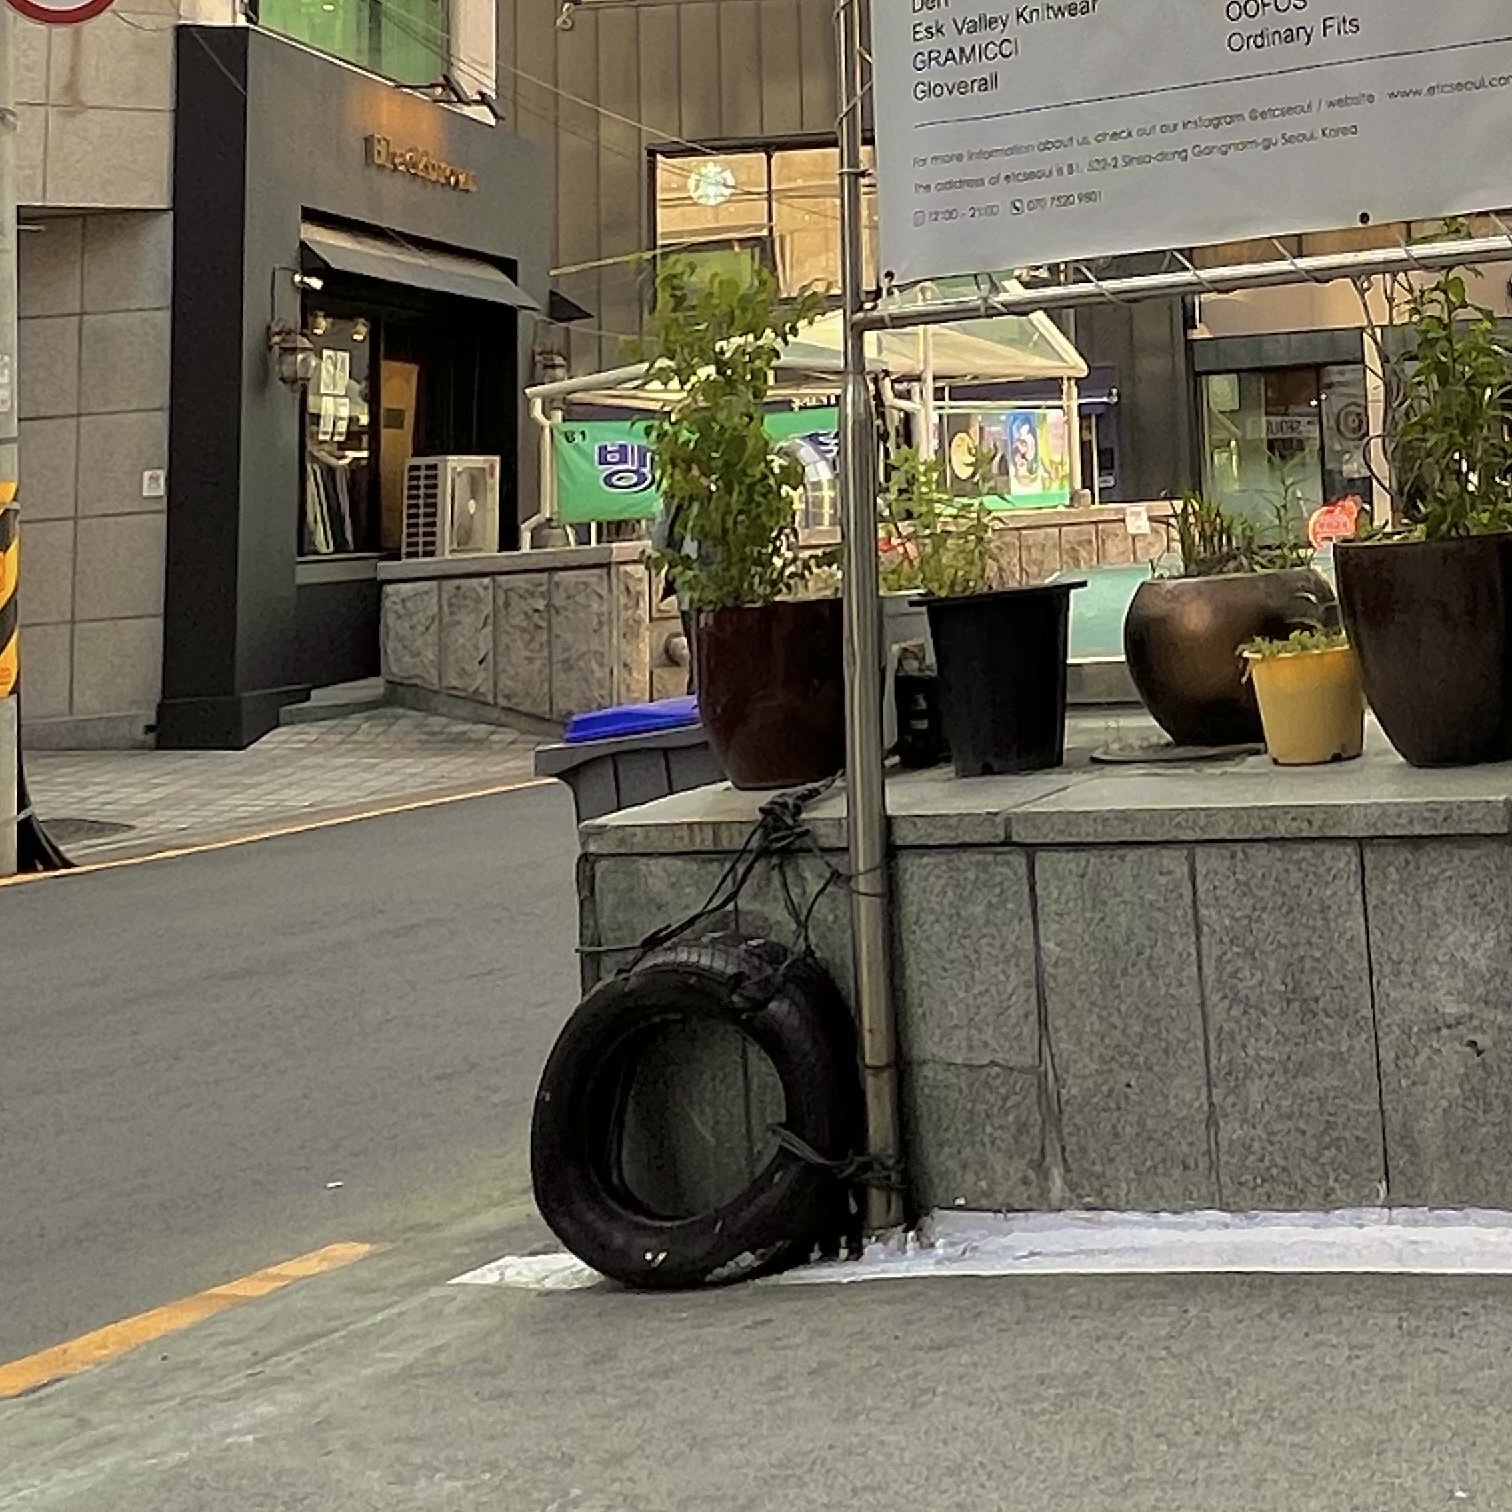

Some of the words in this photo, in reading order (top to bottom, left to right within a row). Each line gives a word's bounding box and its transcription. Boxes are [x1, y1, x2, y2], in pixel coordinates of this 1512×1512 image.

[912, 21, 946, 42] Esk
[952, 6, 1010, 35] Valley
[1226, 23, 1314, 53] Ordinary
[1321, 14, 1360, 39] Fits
[912, 37, 1020, 72] GRAMICCI
[913, 71, 999, 102] Gloverall
